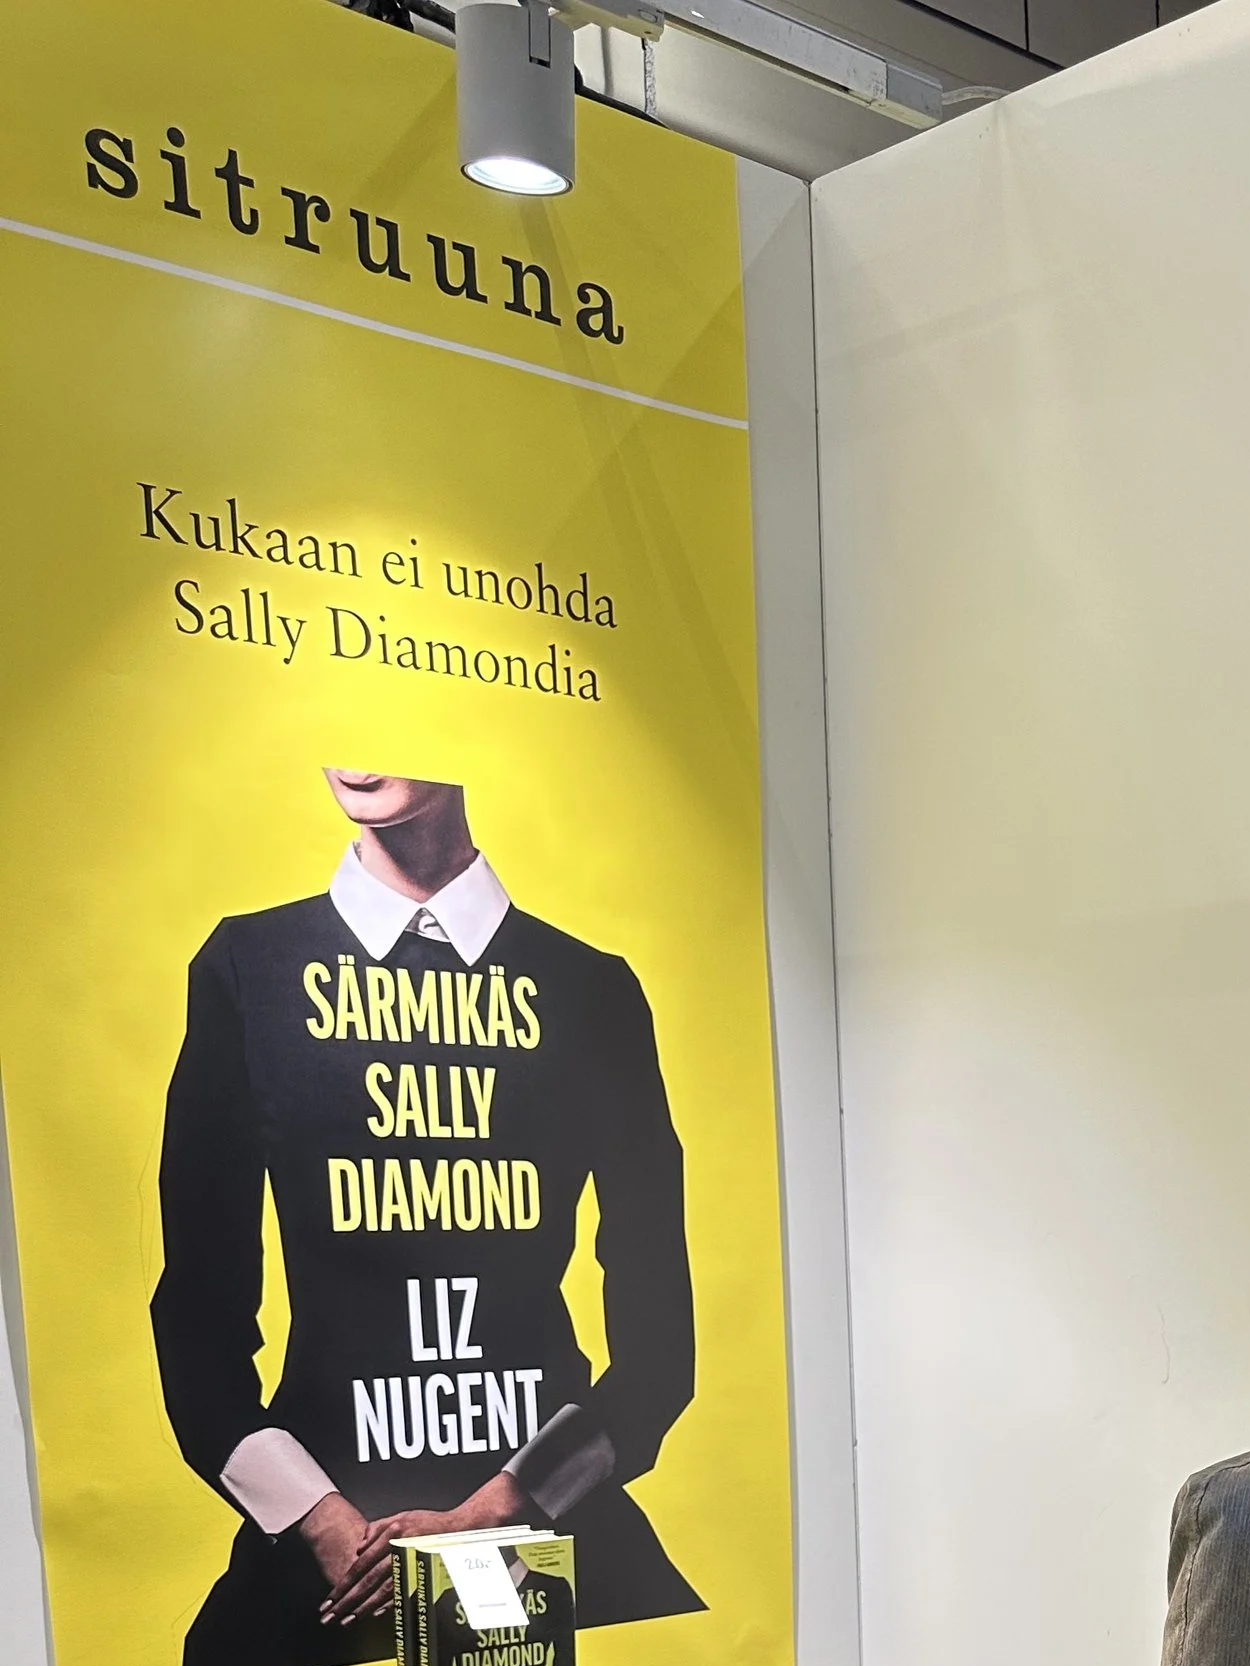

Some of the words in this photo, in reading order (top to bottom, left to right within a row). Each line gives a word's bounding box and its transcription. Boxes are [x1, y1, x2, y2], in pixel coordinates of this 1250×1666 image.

[84, 127, 624, 345] sitruuna
[136, 481, 362, 578] Kukaan
[382, 539, 425, 589] ei
[442, 554, 618, 628] unohda
[173, 580, 306, 665] Sally
[326, 606, 601, 702] Diamondia
[302, 954, 541, 1049] SÄRMIKÄS
[365, 1062, 495, 1139] SALLY
[327, 1158, 540, 1232] DIAMOND
[407, 1277, 482, 1361] LIZ
[352, 1368, 542, 1463] NUGENT
[477, 1626, 526, 1648] SALLY
